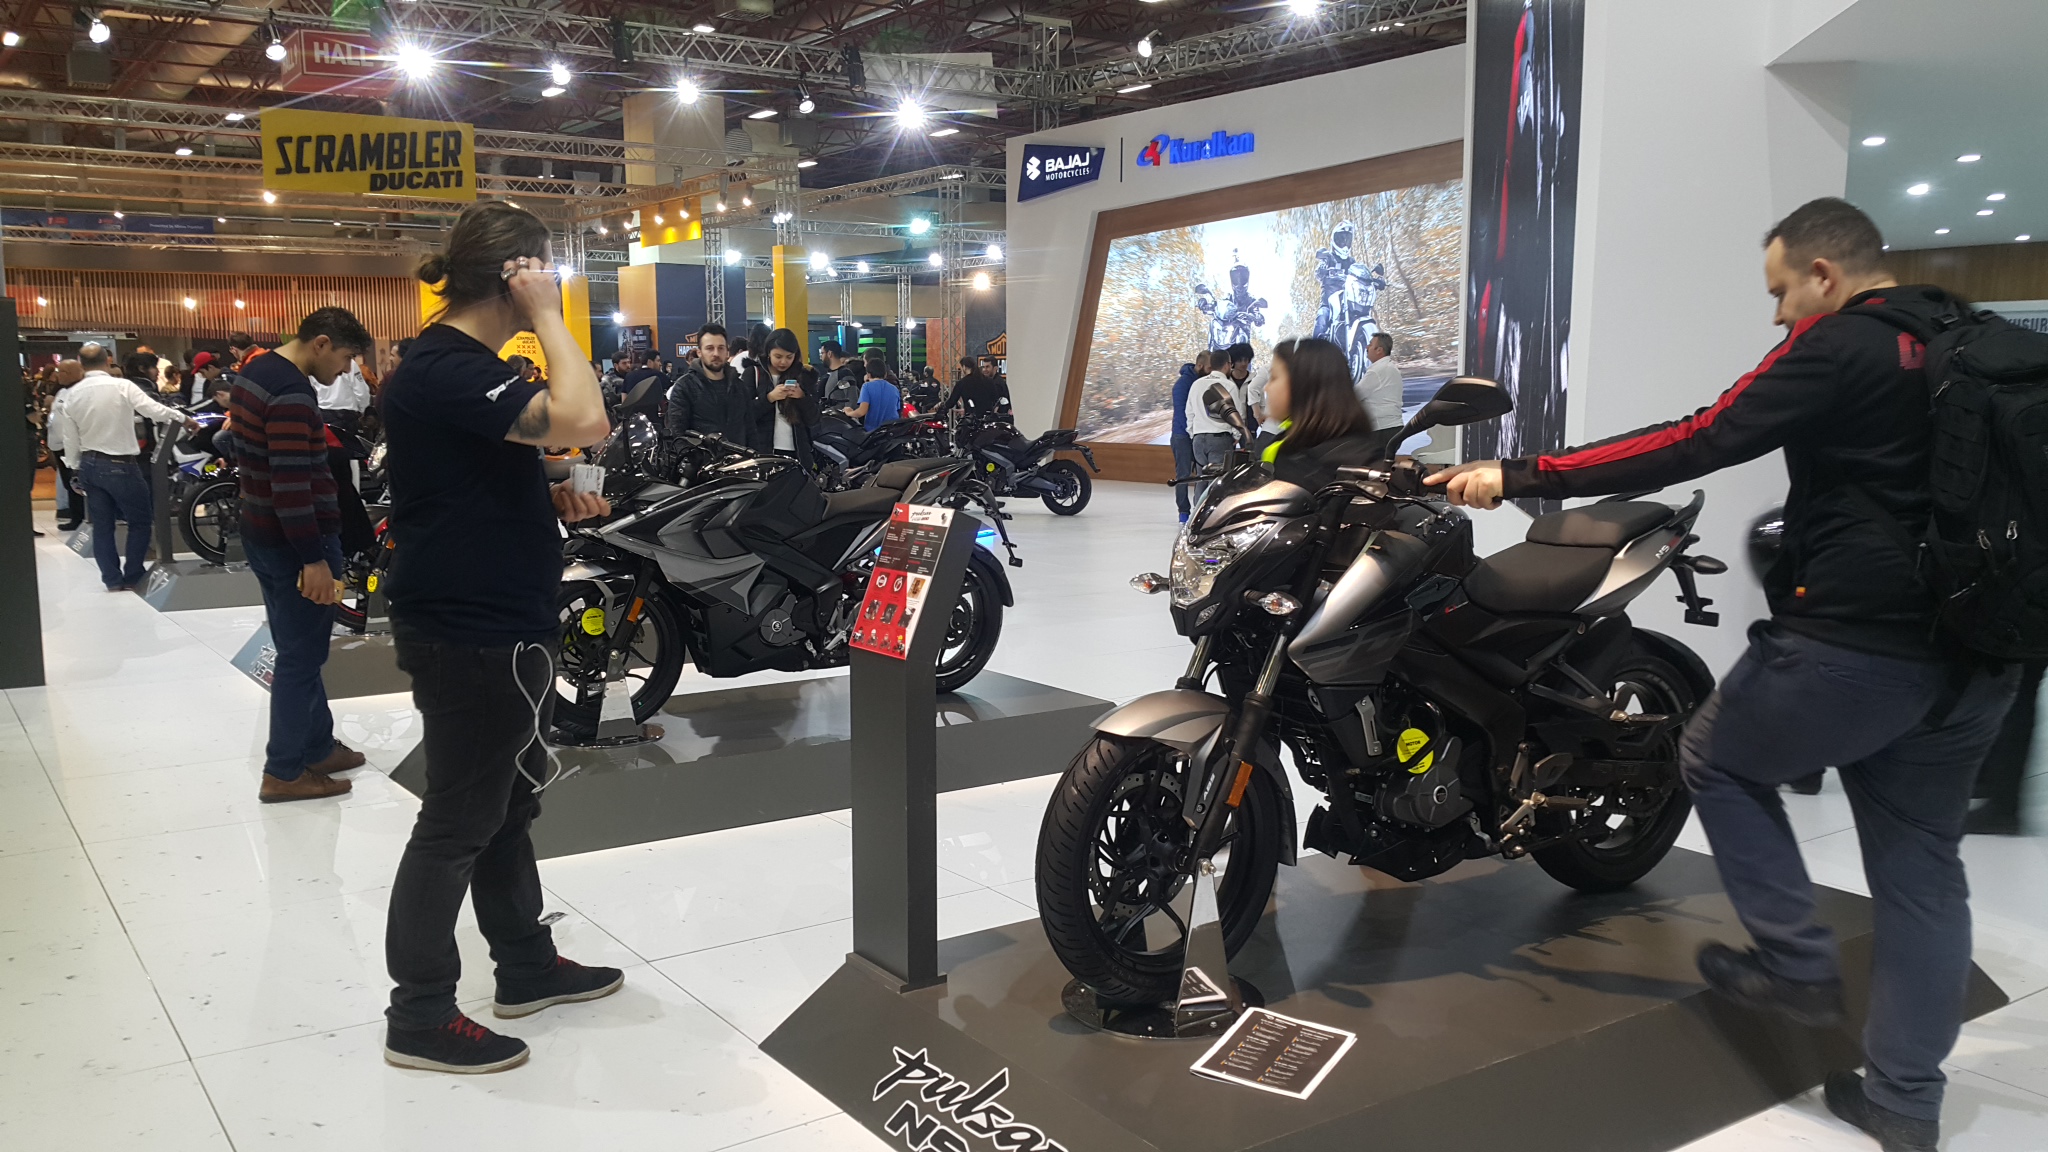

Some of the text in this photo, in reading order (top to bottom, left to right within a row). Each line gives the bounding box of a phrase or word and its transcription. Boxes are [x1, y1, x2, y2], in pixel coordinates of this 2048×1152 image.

[313, 41, 374, 67] HALL
[275, 130, 462, 175] SCRAMBLER
[1169, 130, 1254, 164] Kuralkan
[1045, 152, 1089, 172] BAJAJ
[369, 170, 463, 191] DUCATI
[1045, 167, 1090, 181] MOTORCYCLES
